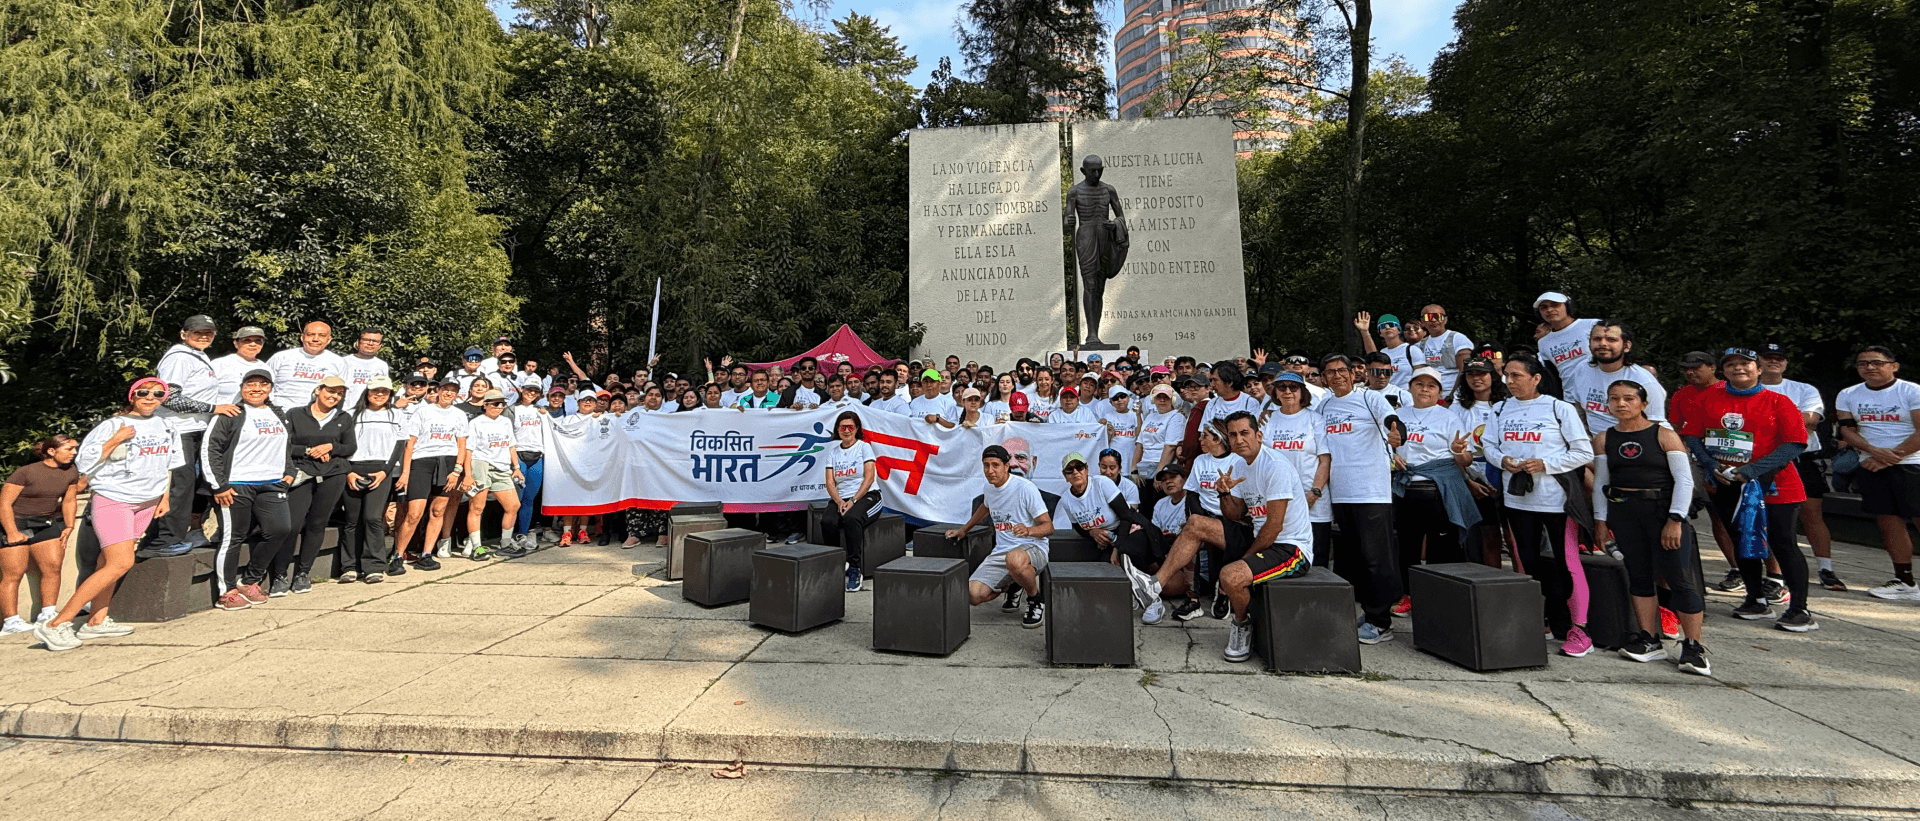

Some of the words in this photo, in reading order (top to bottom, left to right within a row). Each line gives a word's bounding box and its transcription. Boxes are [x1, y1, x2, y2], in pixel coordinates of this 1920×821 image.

[1104, 154, 1160, 168] NUESTRA
[1164, 152, 1204, 166] LUCHA
[933, 164, 946, 175] LA
[949, 163, 963, 174] NO
[967, 160, 1034, 174] VIOLENCIA
[949, 184, 964, 195] HA
[968, 181, 1020, 194] LLEGADO
[1138, 175, 1172, 188] TIENE
[924, 204, 963, 216] HASTA
[969, 203, 990, 216] LOS
[996, 200, 1048, 214] HOMBRES
[1120, 198, 1132, 209] OR
[1136, 196, 1204, 210] PROPOSITO
[938, 226, 944, 238] Y
[948, 223, 1036, 238] PERMANECERA.
[1128, 218, 1134, 231] A
[1139, 217, 1196, 231] AMISTAD
[955, 246, 981, 259] ELLA
[986, 246, 998, 258] ES
[1002, 245, 1016, 258] LA
[1148, 240, 1170, 252] CON
[942, 266, 1030, 281] ANUNCIADORA
[1122, 262, 1165, 274] MUNDO
[1169, 261, 1215, 274] ENTERO
[957, 290, 970, 302] DE
[974, 289, 988, 301] LA
[992, 288, 1014, 300] PAZ
[976, 311, 996, 323] DEL
[1104, 310, 1138, 318] HANDAS
[1141, 308, 1201, 318] KARAMCHAND
[1204, 308, 1236, 316] GANDHI
[966, 333, 1006, 346] MUNDO
[1133, 332, 1154, 341] 1869
[1175, 332, 1196, 340] 1948
[1554, 347, 1582, 364] RUN
[293, 371, 324, 380] RUN
[1586, 402, 1608, 412] RU
[259, 427, 283, 435] RUN
[1326, 423, 1352, 434] RUN
[430, 433, 453, 441] RUN
[690, 430, 754, 451] विकसित
[1504, 432, 1542, 441] RUN
[1718, 438, 1734, 446] 1159
[139, 446, 169, 456] RUN
[1273, 441, 1304, 450] RUN
[691, 454, 761, 482] भारत
[862, 428, 940, 495] न
[834, 468, 857, 477] RUN
[1081, 515, 1105, 528] RUN
